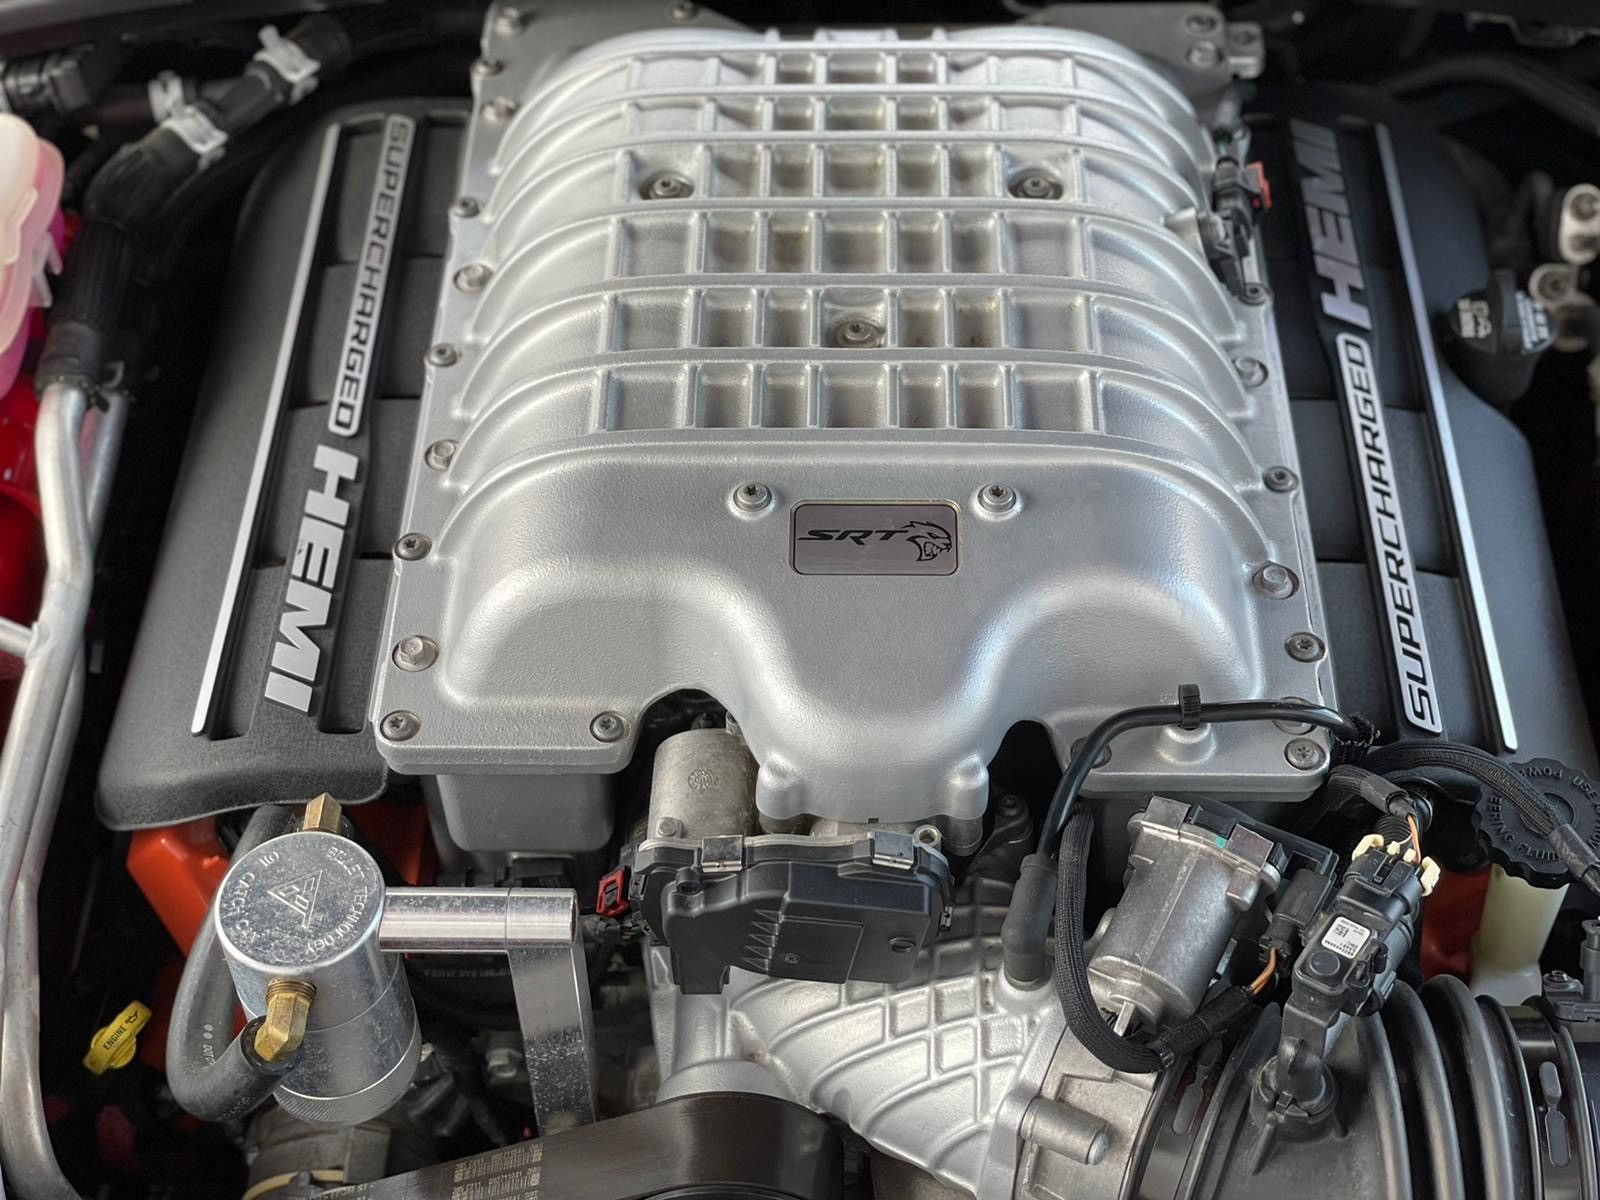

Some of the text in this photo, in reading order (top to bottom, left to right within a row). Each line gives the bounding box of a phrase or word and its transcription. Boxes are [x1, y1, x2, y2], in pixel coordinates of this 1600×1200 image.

[334, 121, 408, 430] SUPERCHARGED
[1289, 118, 1372, 331] HEMI
[264, 444, 359, 713] HEMI
[797, 529, 909, 546] SRT
[1344, 339, 1437, 726] SUPERCHARGED
[102, 1024, 128, 1051] ENGINE
